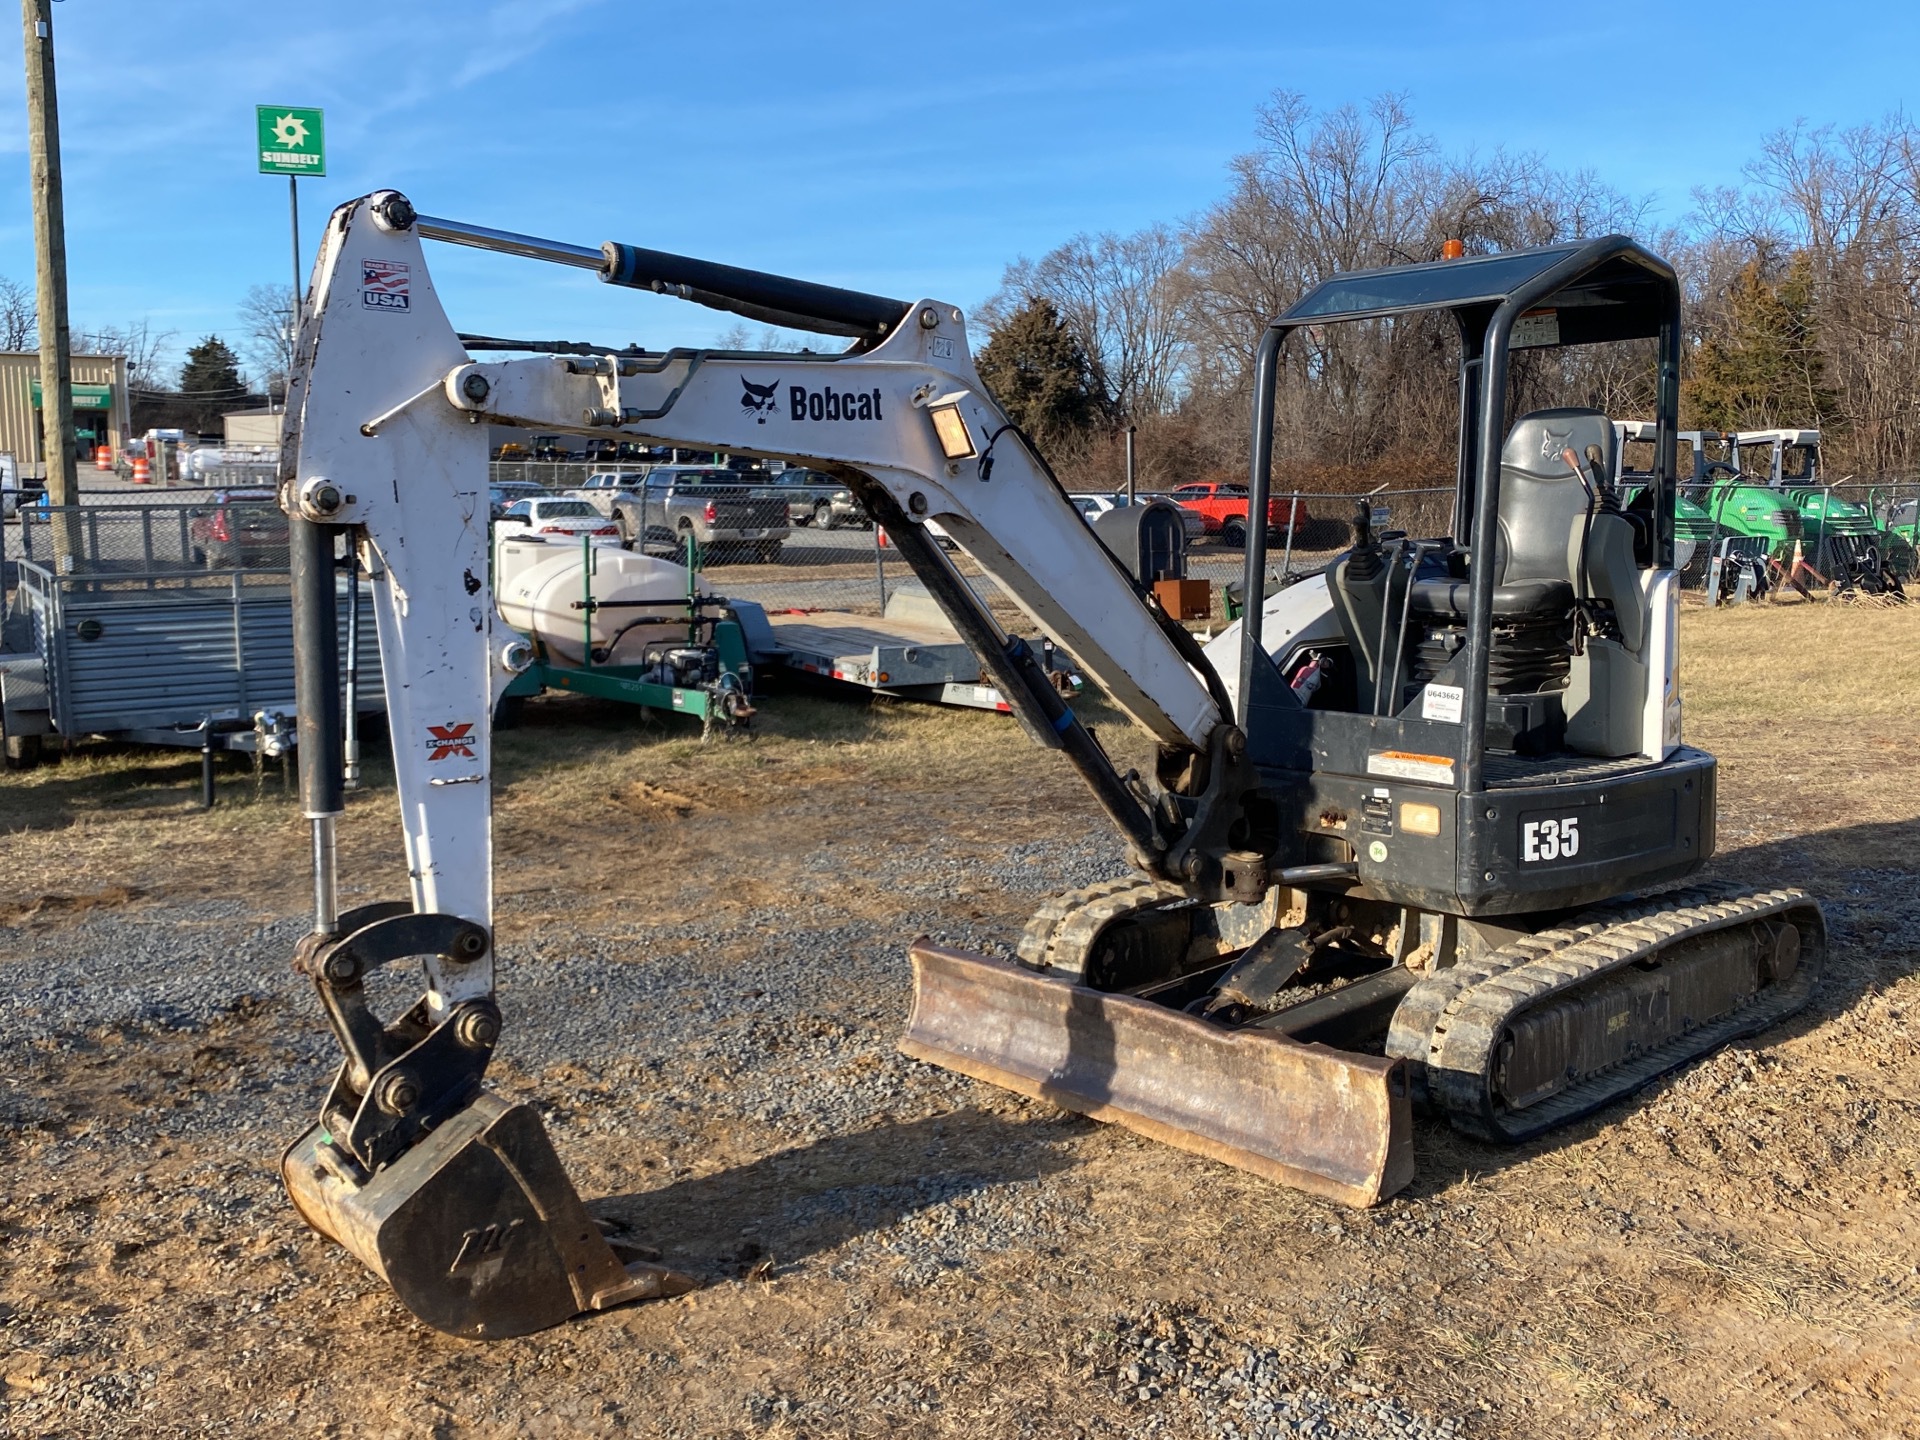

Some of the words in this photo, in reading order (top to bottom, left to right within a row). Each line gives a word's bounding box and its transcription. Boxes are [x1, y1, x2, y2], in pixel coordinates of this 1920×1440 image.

[262, 151, 320, 165] SUNBELT
[366, 292, 407, 308] USA
[789, 386, 883, 421] Bobcat
[1427, 690, 1460, 701] U643662
[1401, 754, 1427, 762] WARNING
[1524, 817, 1579, 862] E35
